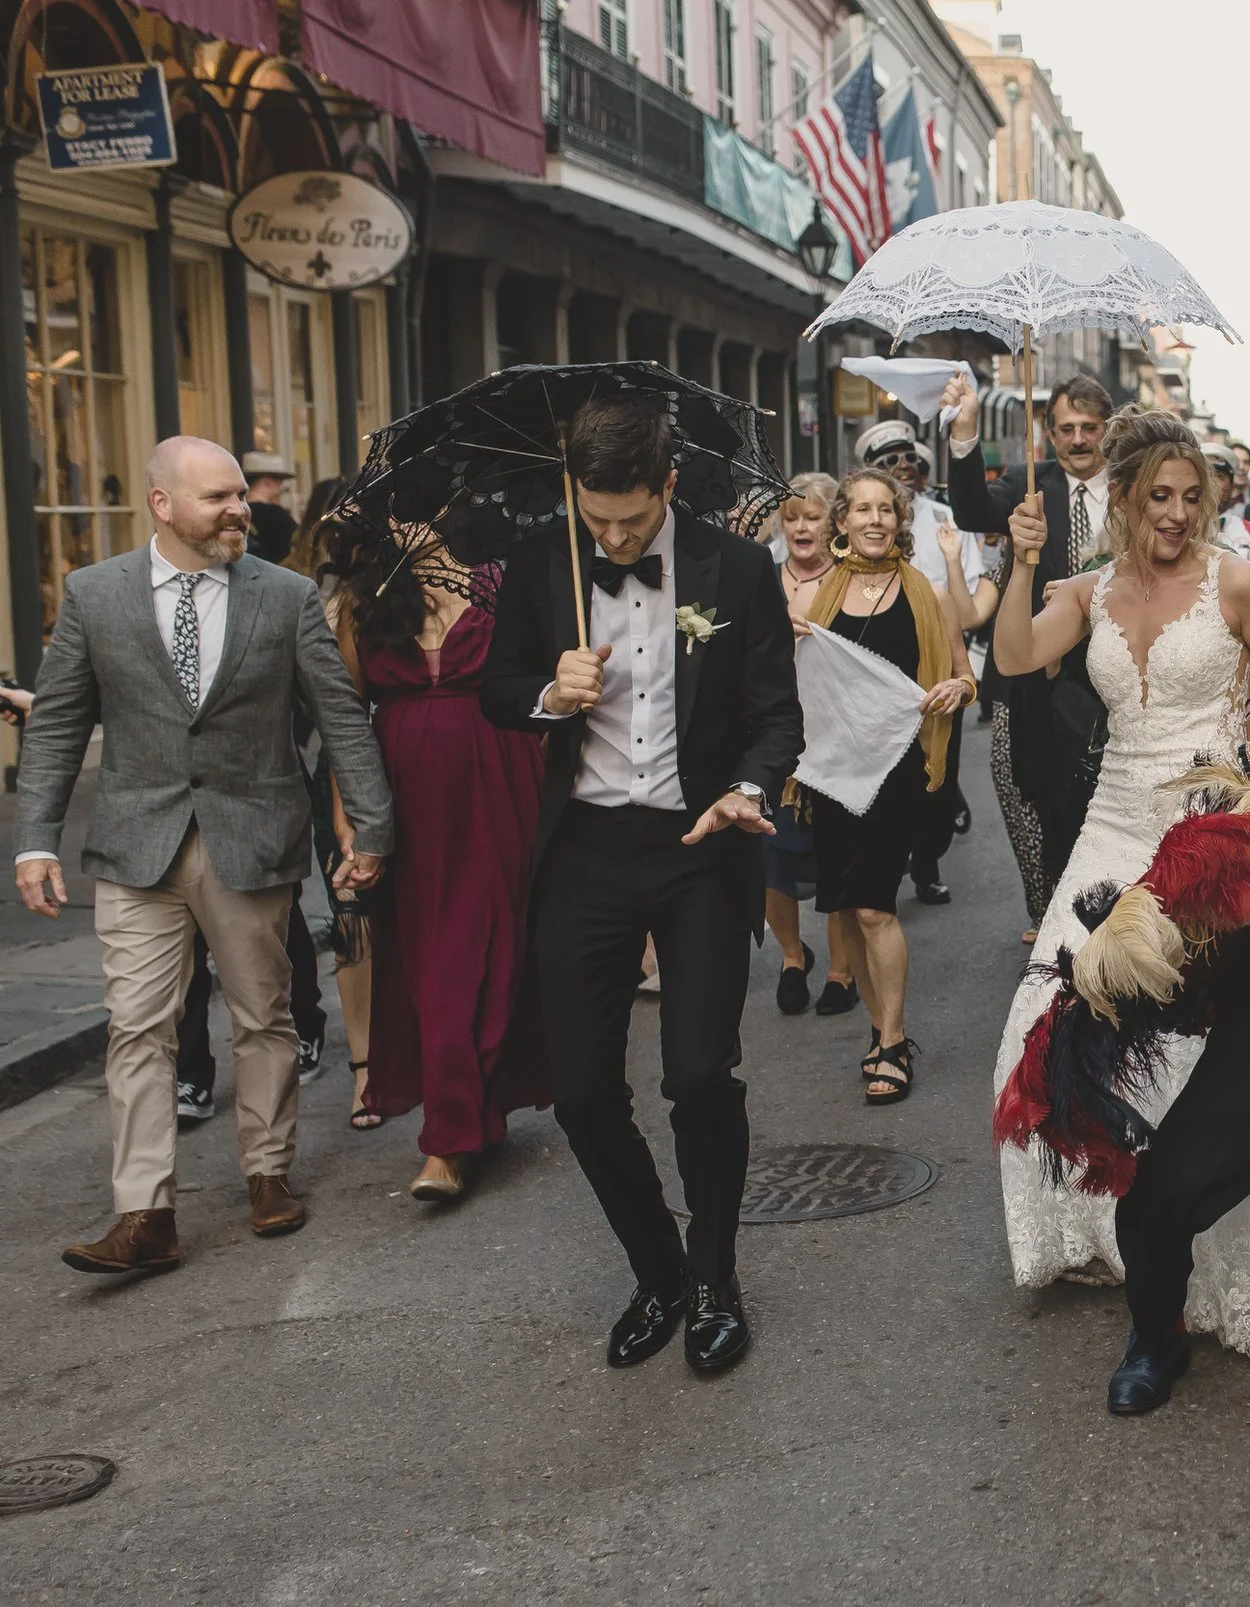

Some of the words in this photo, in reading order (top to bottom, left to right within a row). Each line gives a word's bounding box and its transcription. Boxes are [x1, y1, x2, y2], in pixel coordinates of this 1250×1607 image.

[52, 70, 143, 91] APARTMENT
[60, 89, 92, 104] FOR
[94, 84, 139, 100] LEASE
[316, 216, 345, 246] de
[350, 219, 401, 250] Paris
